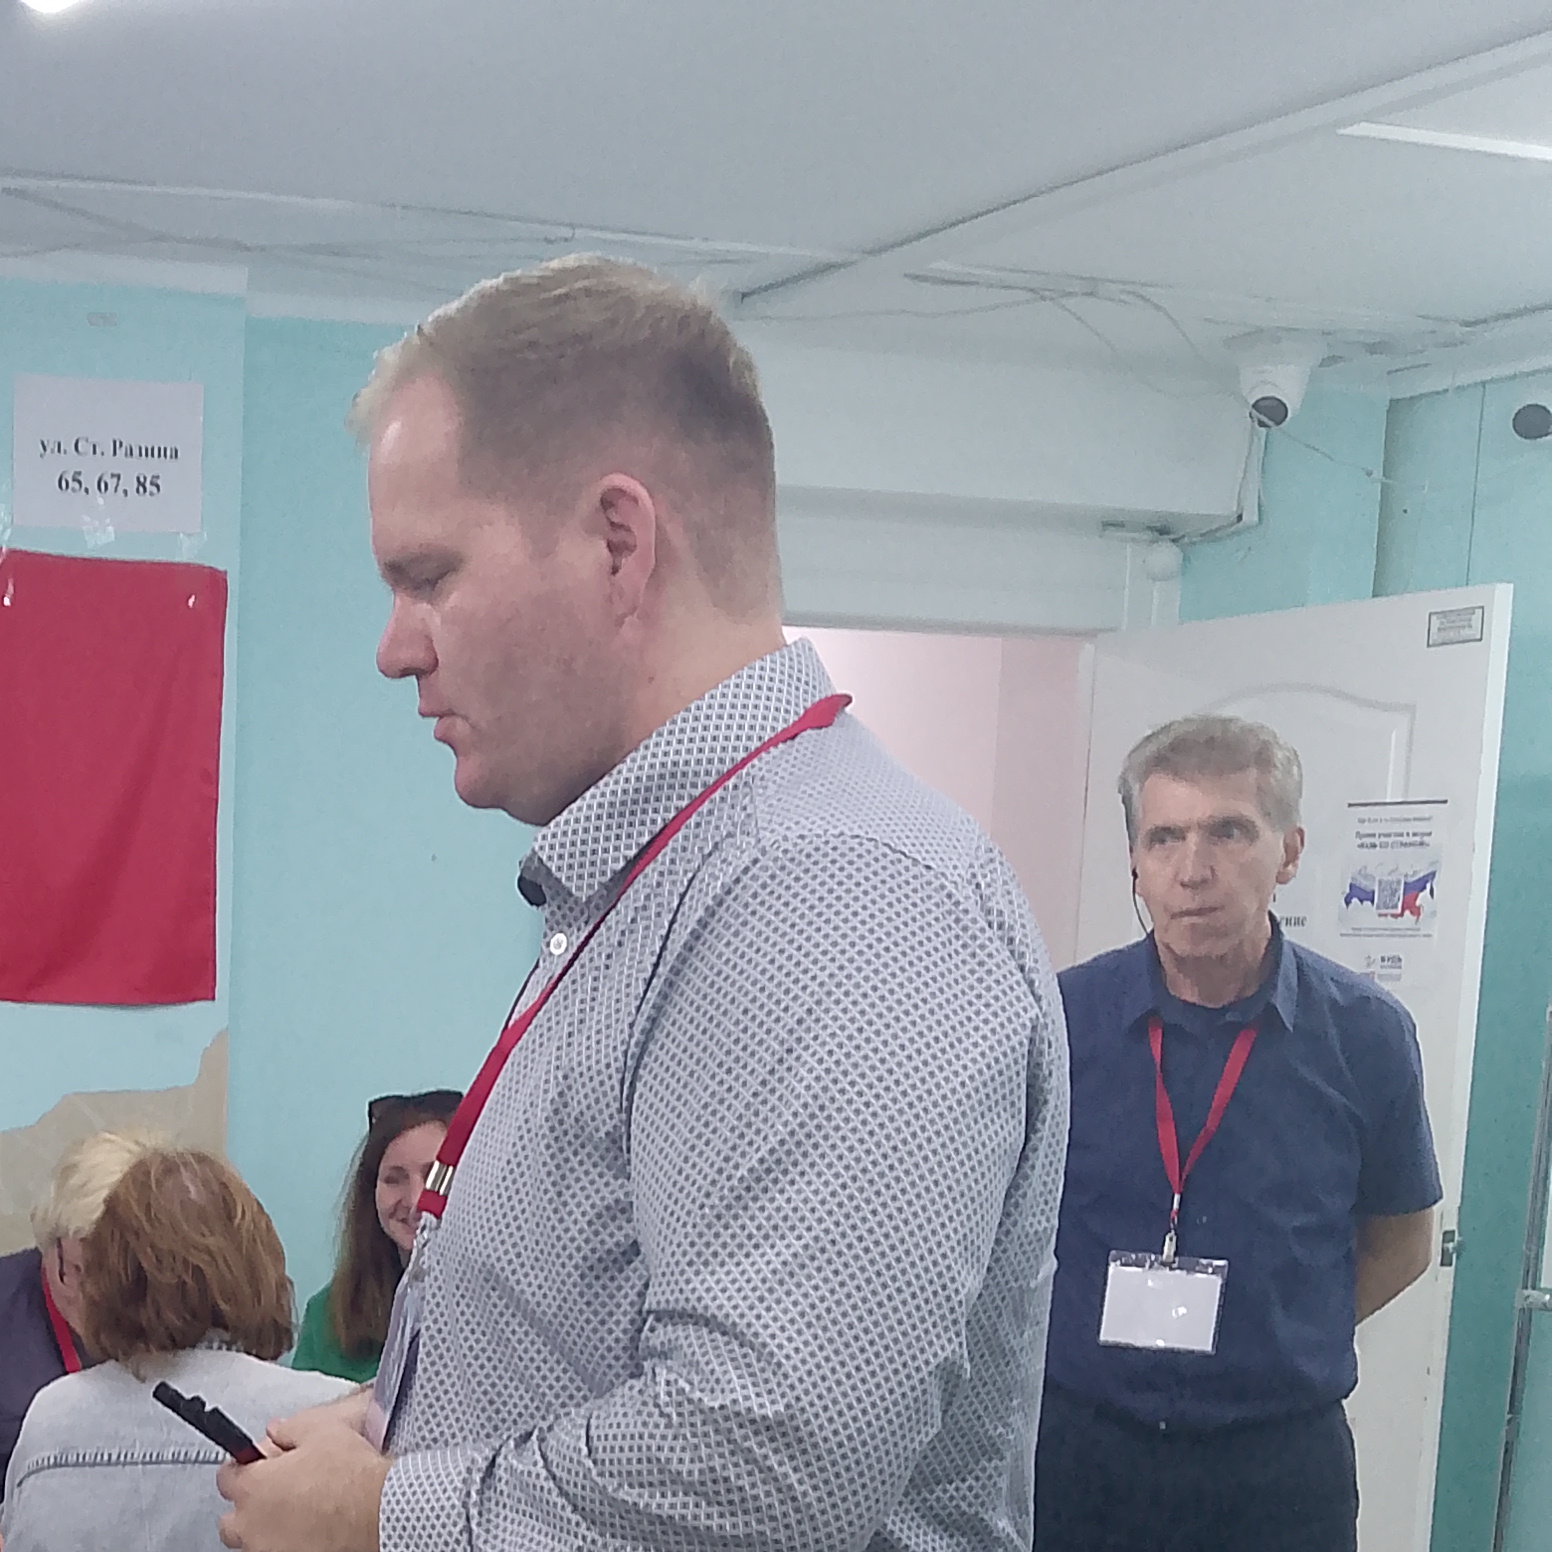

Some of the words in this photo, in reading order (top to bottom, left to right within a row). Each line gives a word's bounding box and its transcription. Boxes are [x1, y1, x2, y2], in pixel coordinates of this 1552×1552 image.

[39, 438, 68, 459] ул.
[73, 436, 105, 457] Ст.
[112, 438, 180, 461] Разина
[57, 470, 90, 495] 65,
[97, 472, 129, 497] 67,
[135, 474, 161, 498] 85
